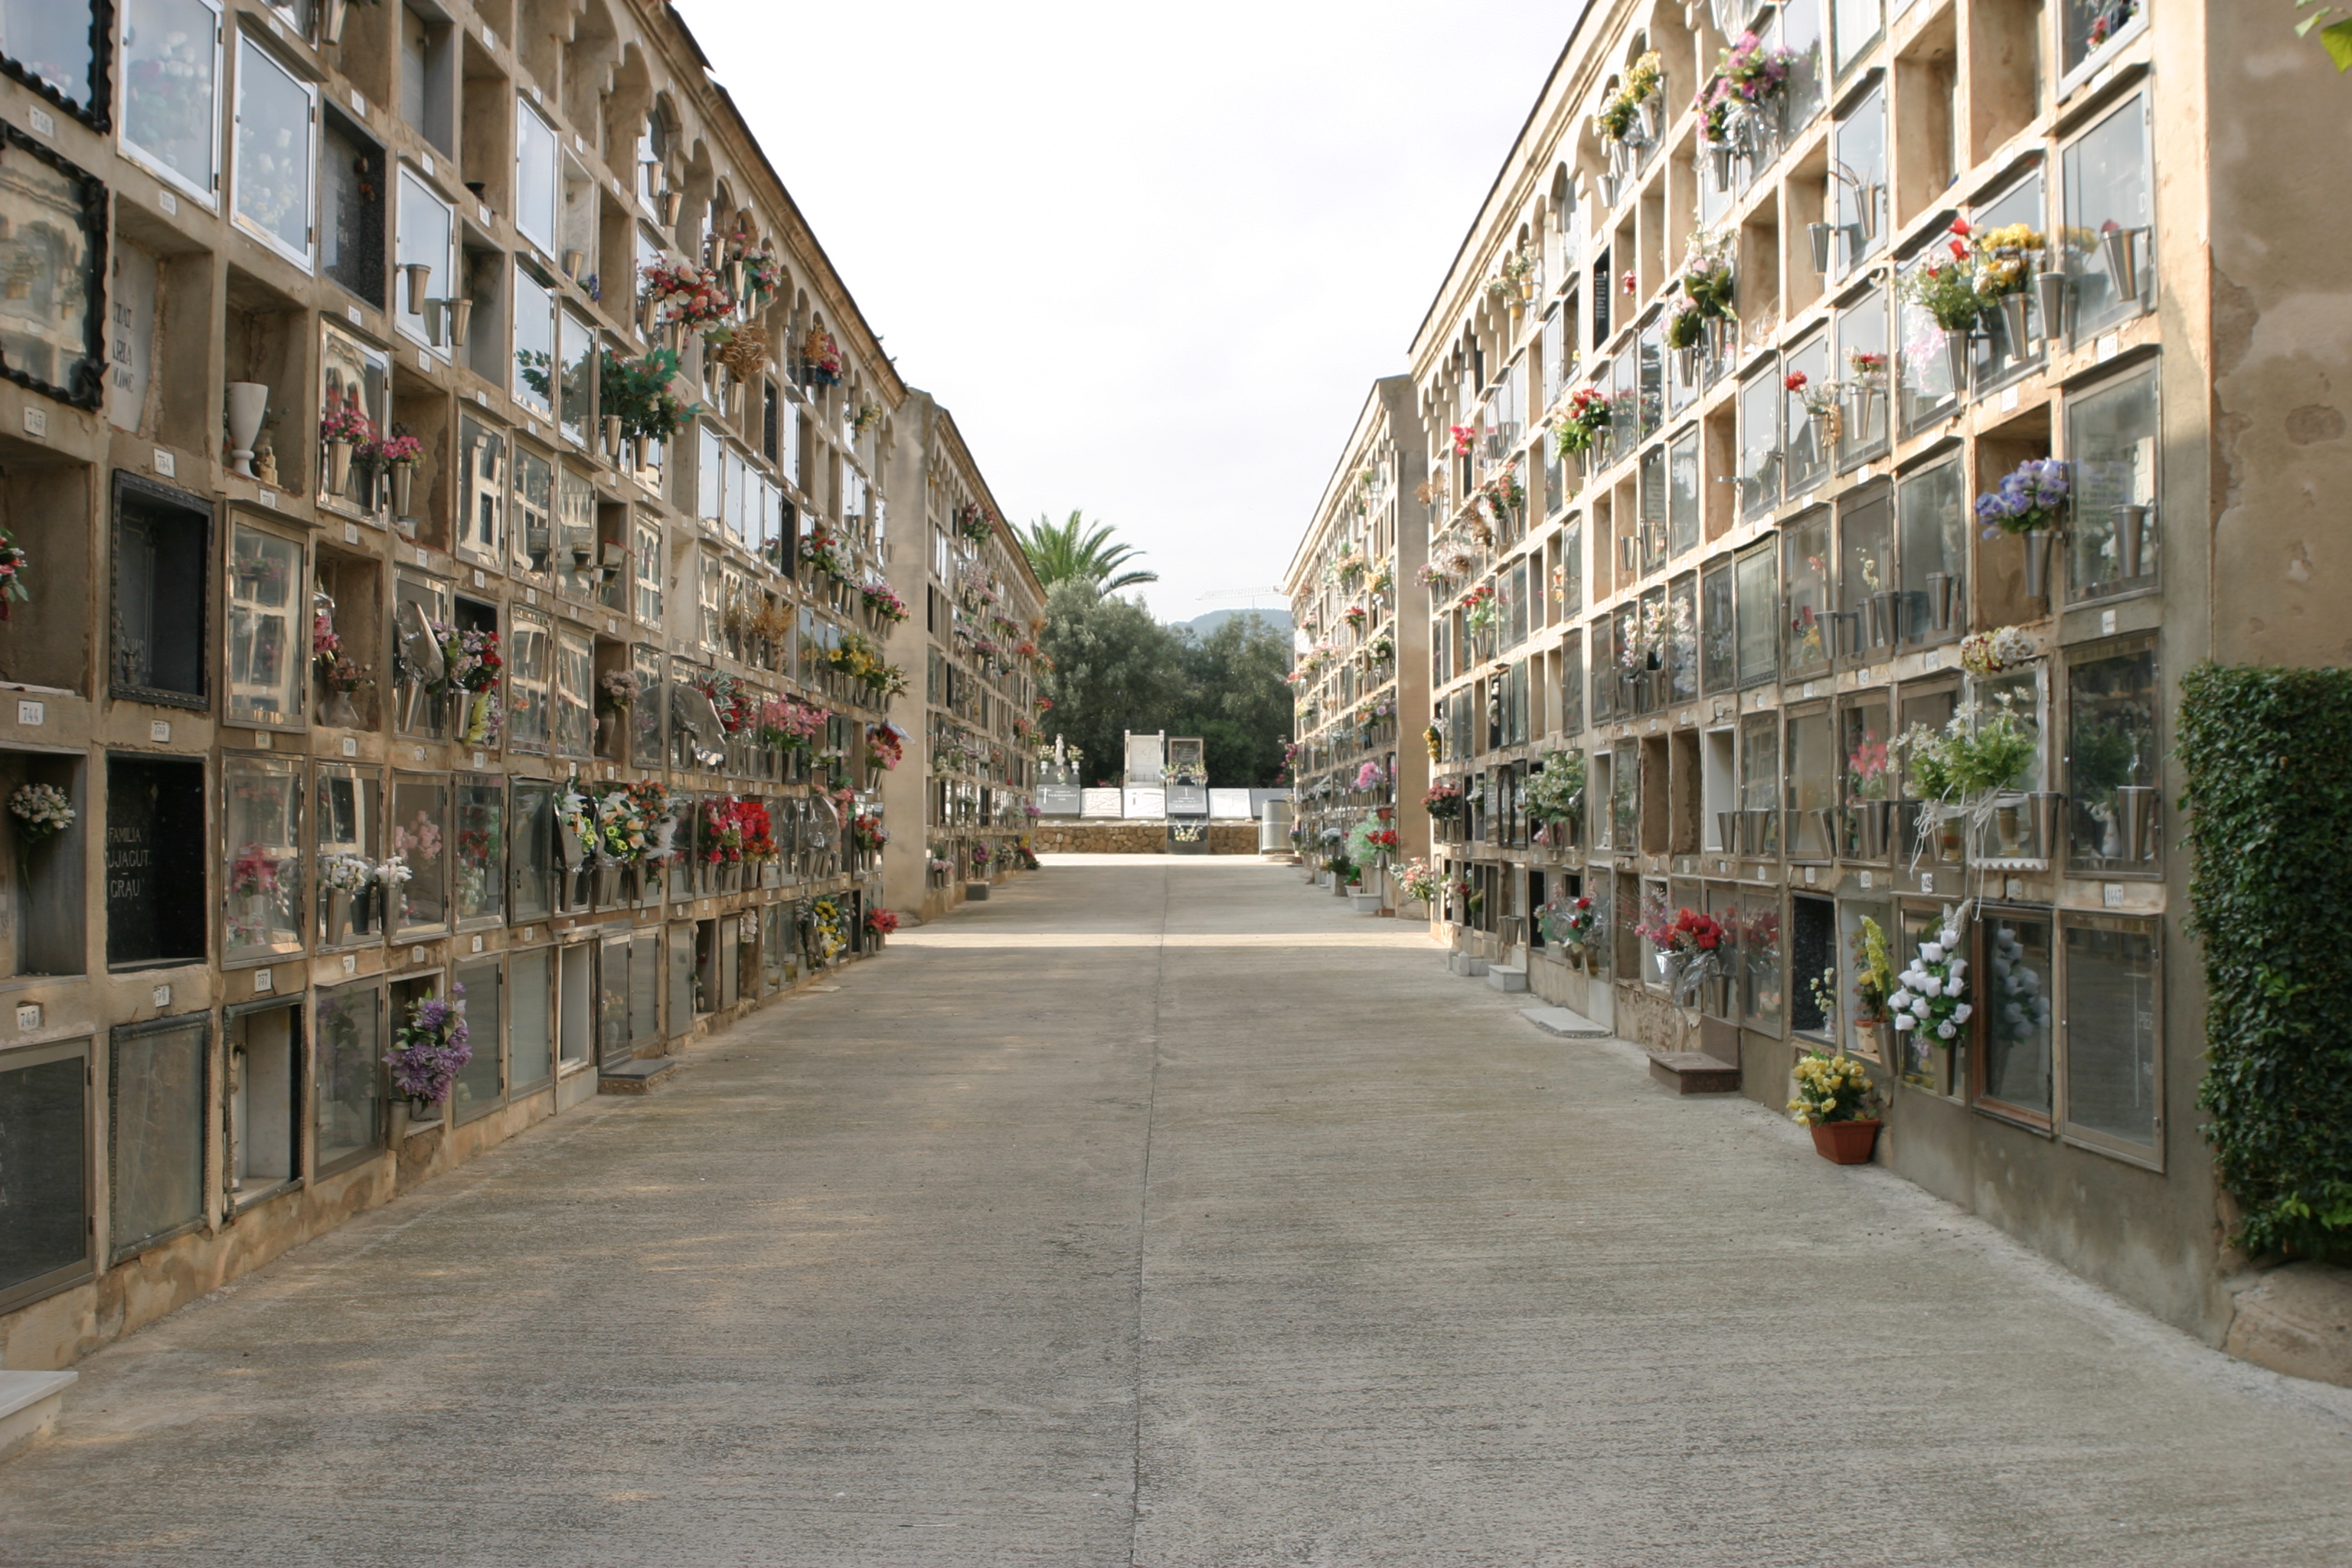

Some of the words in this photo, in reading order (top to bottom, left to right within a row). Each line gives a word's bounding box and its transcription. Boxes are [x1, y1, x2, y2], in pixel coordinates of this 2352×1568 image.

[158, 455, 171, 472] 754
[23, 707, 38, 722] 744
[109, 828, 142, 843] FAMILIA
[110, 878, 140, 898] GRAU
[2107, 888, 2123, 903] 1443
[21, 1011, 37, 1027] 743
